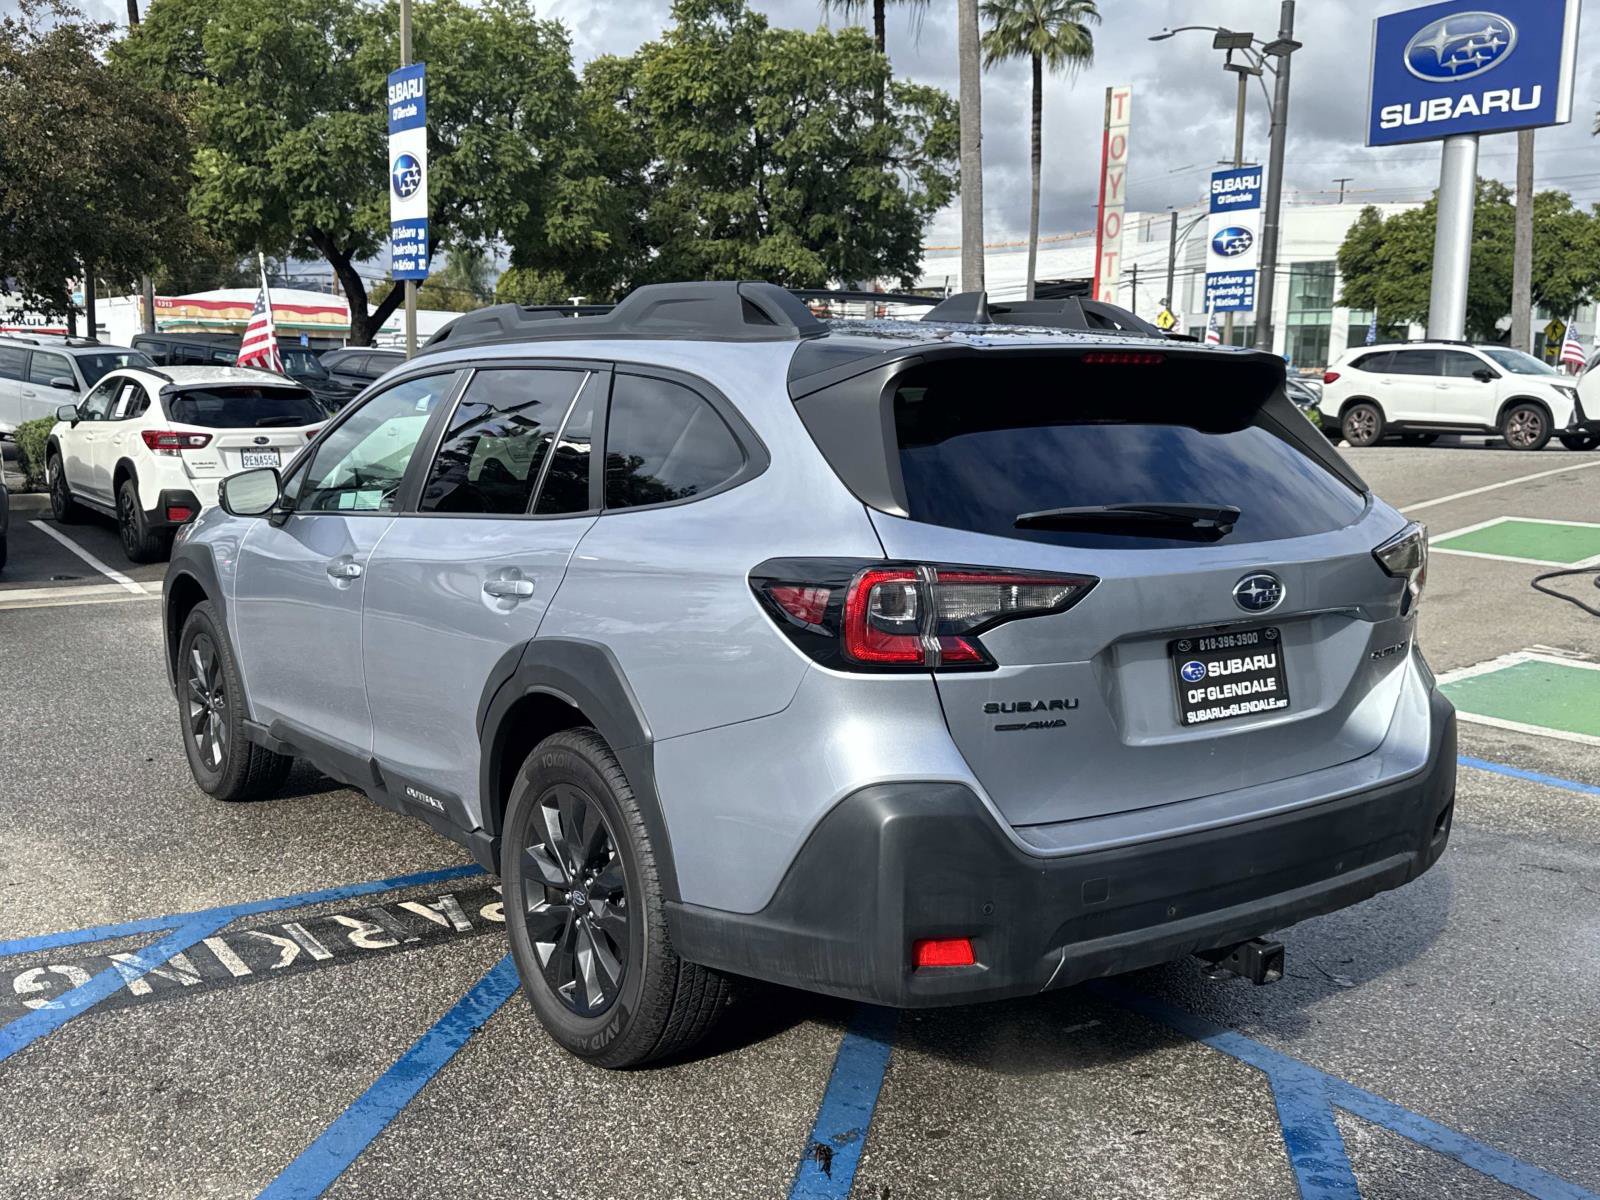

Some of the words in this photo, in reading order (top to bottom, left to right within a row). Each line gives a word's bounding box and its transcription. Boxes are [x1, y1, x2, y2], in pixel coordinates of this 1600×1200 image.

[388, 77, 424, 106] SUBARU
[1379, 85, 1542, 129] SUBARU
[1212, 175, 1260, 194] SUBARU
[1217, 275, 1243, 285] Subaru
[1206, 286, 1244, 296] Dealership
[1199, 632, 1259, 652] 818-396-3900
[1207, 653, 1276, 677] SUBARU
[1187, 688, 1206, 704] OF
[1207, 677, 1277, 701] GLENDALE
[983, 698, 1079, 714] SUBARU
